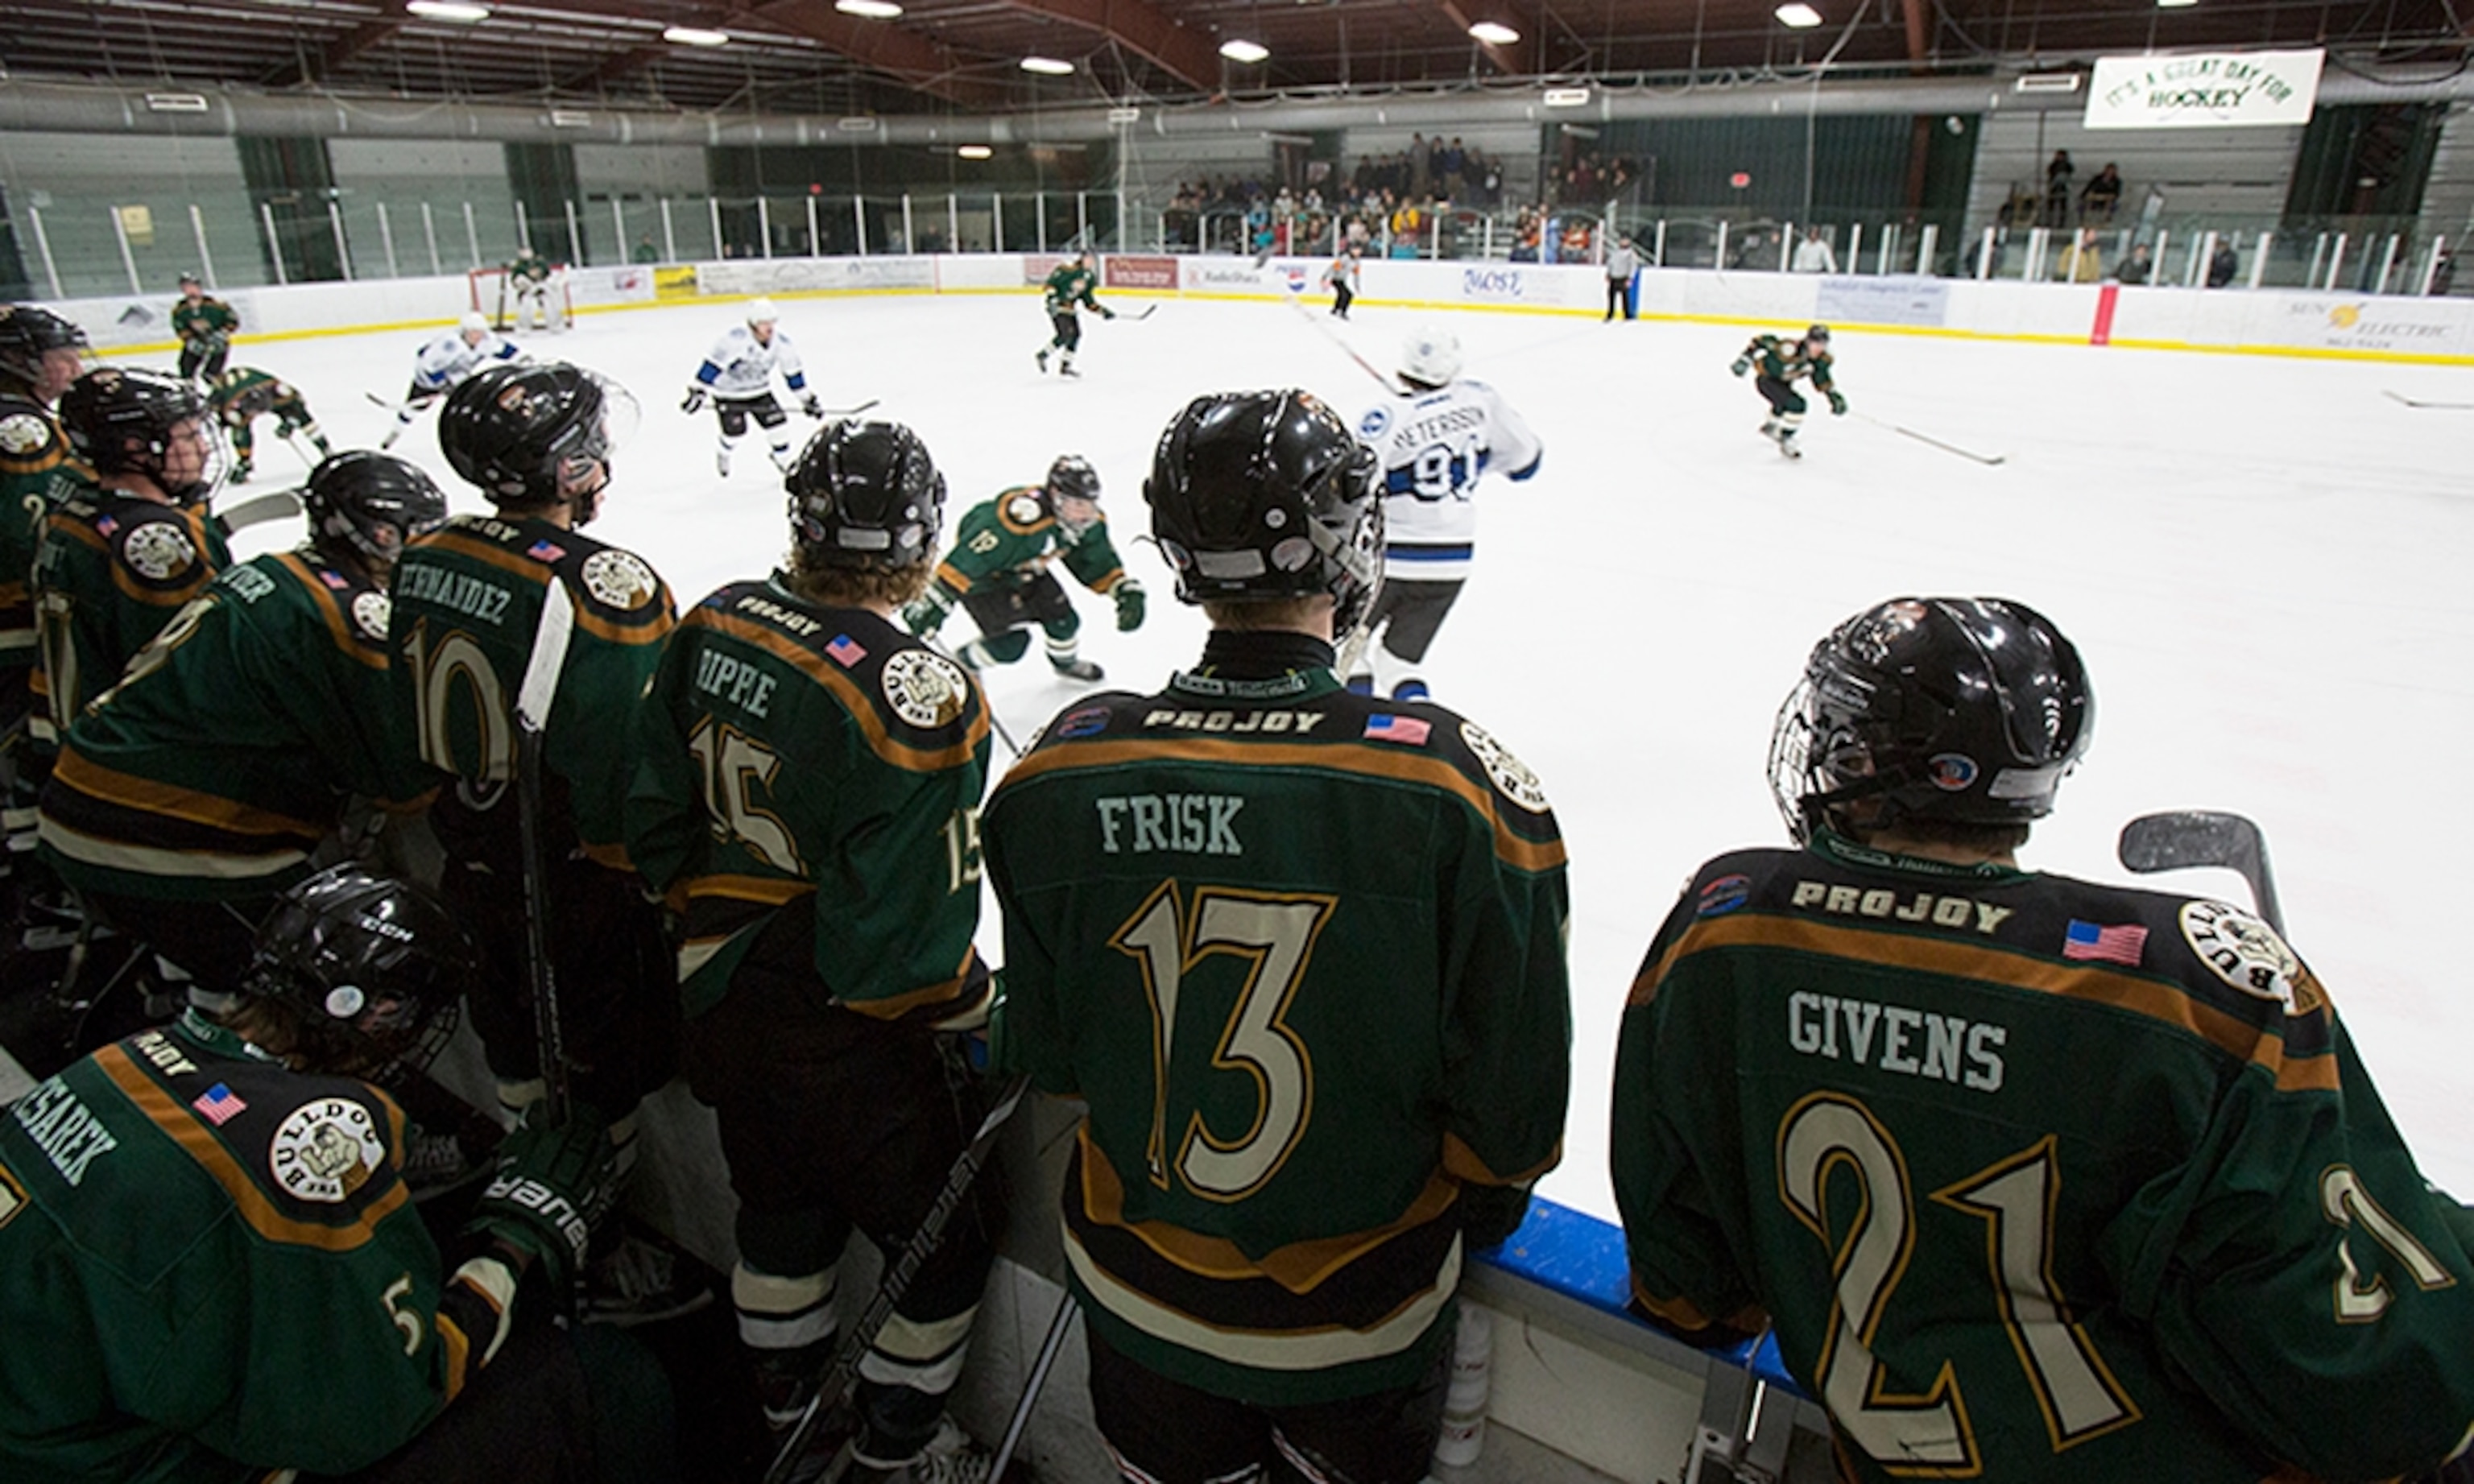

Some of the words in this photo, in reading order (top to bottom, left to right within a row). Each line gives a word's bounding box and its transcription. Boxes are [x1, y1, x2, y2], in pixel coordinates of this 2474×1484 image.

[2146, 72, 2155, 85] A
[2164, 60, 2221, 81] GREAT
[2224, 62, 2258, 82] DAY
[2258, 74, 2294, 104] FOR
[2149, 85, 2252, 109] HOCKEY
[736, 595, 823, 638] PROJOY
[1143, 709, 1325, 734] PROJOY
[689, 713, 809, 878] 15
[1096, 792, 1244, 856] FRISK
[1790, 880, 2011, 935] PROJOY
[1107, 878, 1338, 1203] 13
[1788, 990, 2007, 1093] GIVENS
[277, 1103, 377, 1188] BULLDOG
[1775, 1089, 2145, 1480] 21
[2319, 1162, 2459, 1324] 21
[382, 1272, 423, 1357] 5
